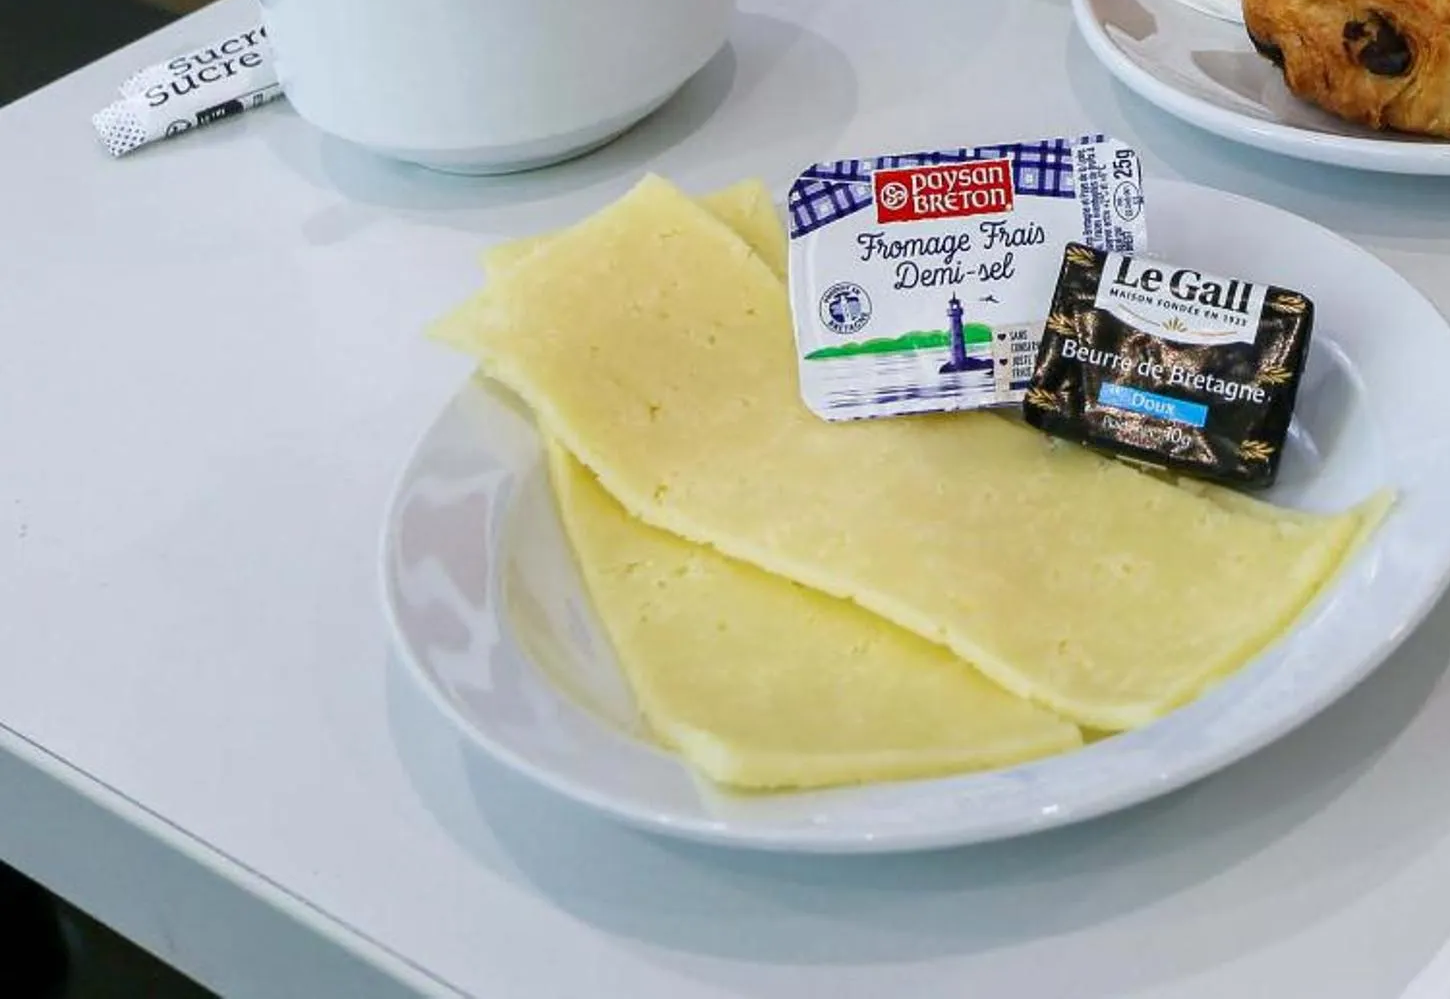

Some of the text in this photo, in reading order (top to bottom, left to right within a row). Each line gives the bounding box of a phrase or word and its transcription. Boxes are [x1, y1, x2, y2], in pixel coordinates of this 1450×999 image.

[144, 51, 263, 107] Sucre
[1112, 149, 1136, 179] 25g
[857, 220, 1045, 264] Fromage Frais
[894, 252, 1016, 290] Demi-sel
[1112, 255, 1253, 315] Le Gall
[1109, 288, 1153, 304] MAISON
[1204, 310, 1219, 320] EN
[1061, 338, 1266, 404] Beurre de Bretagne
[1131, 392, 1176, 415] Doux
